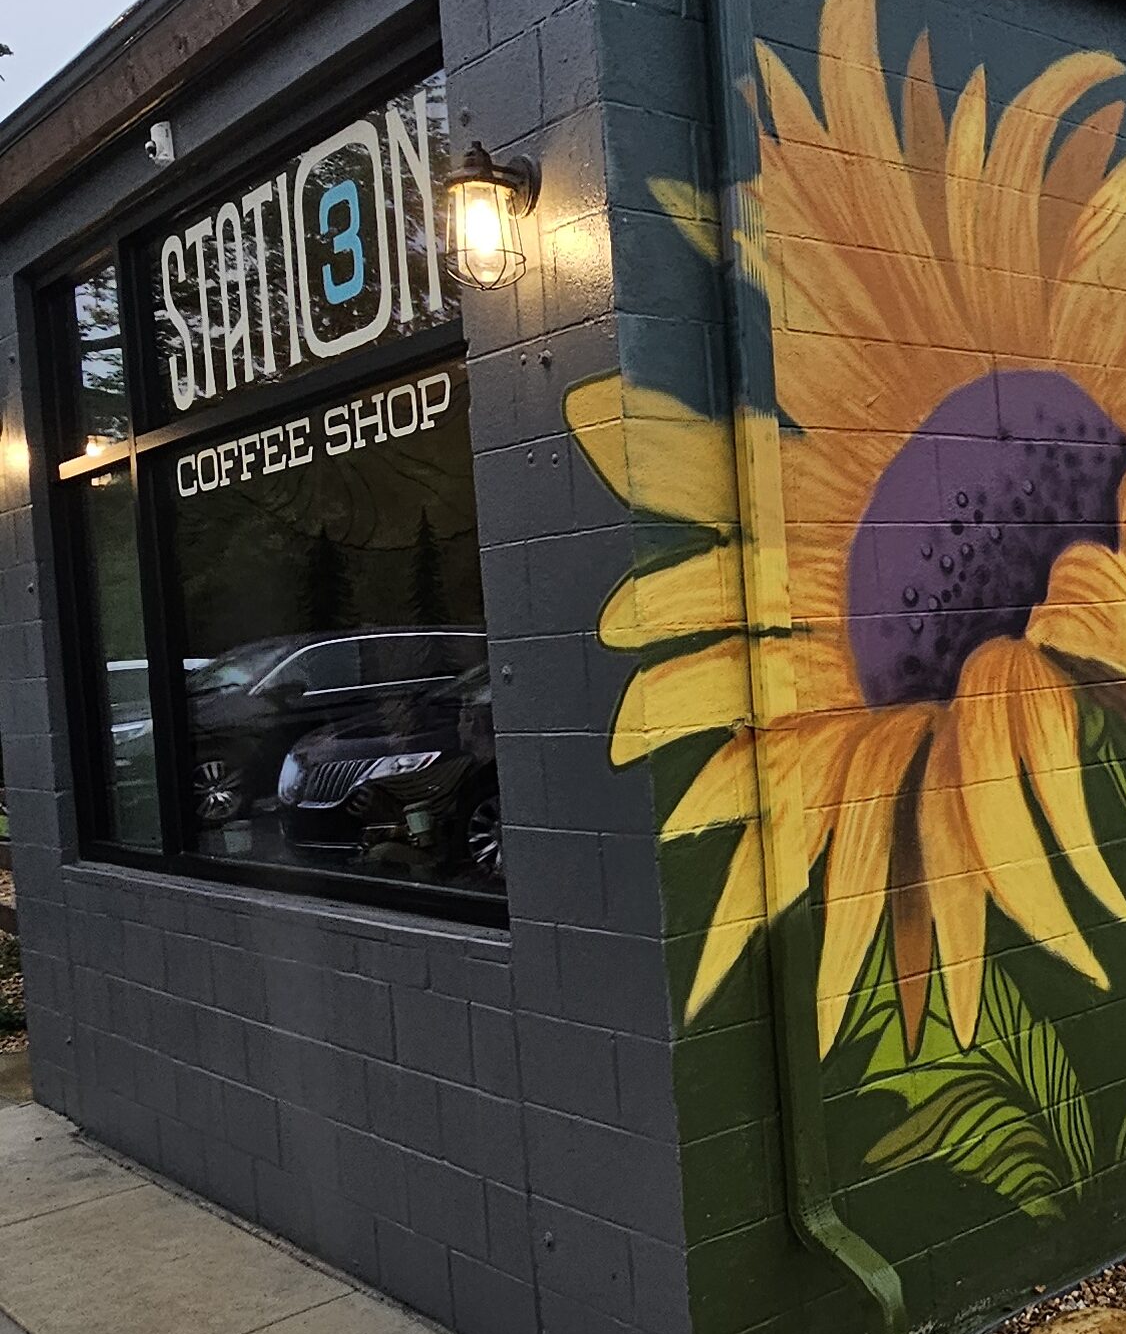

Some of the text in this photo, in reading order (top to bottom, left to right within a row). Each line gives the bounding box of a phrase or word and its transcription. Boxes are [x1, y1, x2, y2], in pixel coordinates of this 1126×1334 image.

[161, 89, 444, 411] STATION
[318, 179, 365, 306] 3
[176, 372, 452, 498] COFFEE SHOP
